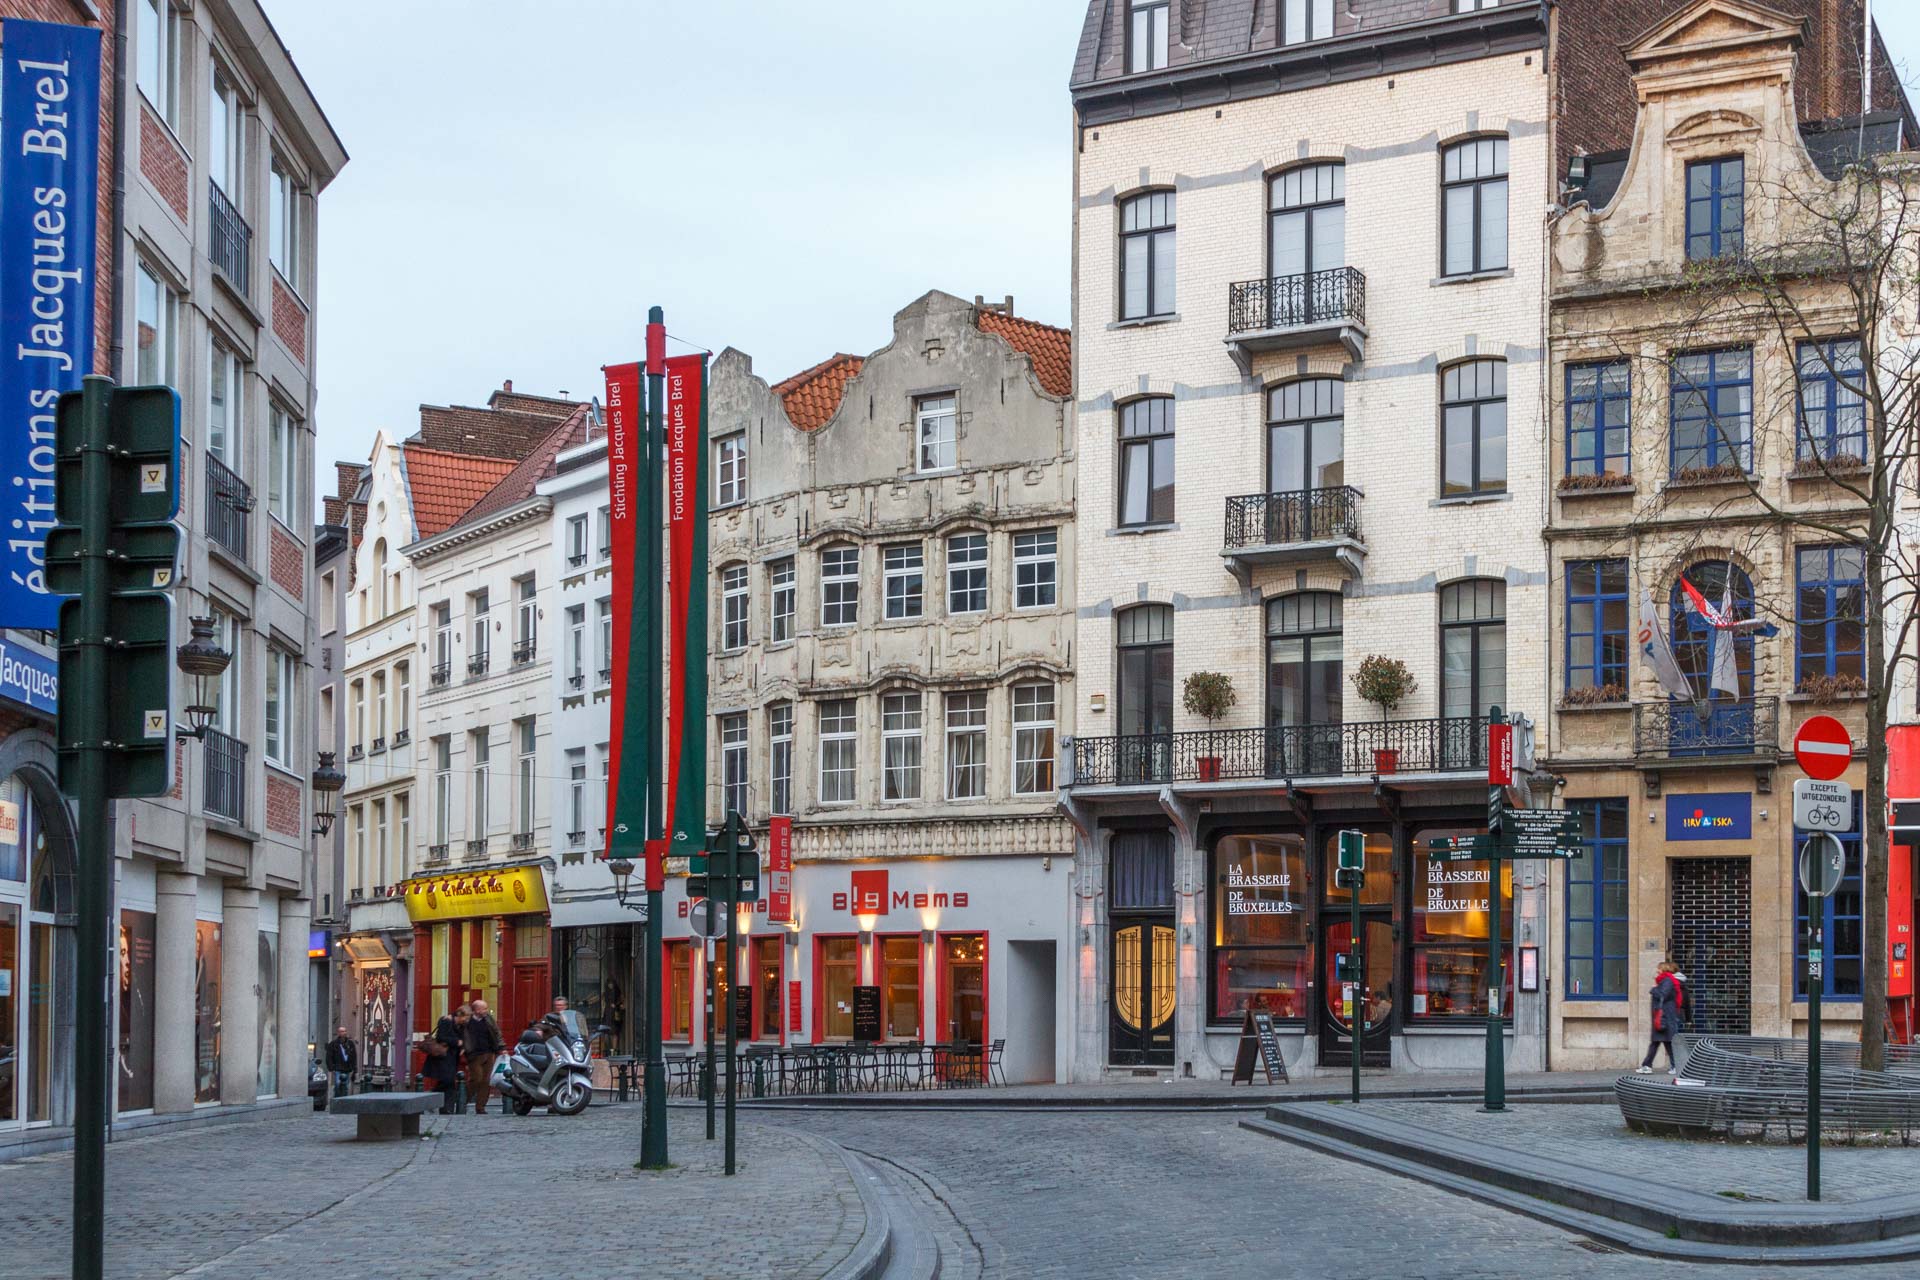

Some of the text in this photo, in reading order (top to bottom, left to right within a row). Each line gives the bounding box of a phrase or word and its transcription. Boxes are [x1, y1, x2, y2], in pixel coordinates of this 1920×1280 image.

[9, 59, 82, 594] éditions Jacques Brel
[610, 382, 627, 520] Stichting Jacques Brel
[671, 375, 686, 521] Fondation Jacques Brel
[0, 644, 58, 705] Jacques
[1801, 792, 1847, 803] UITGEZONDERD
[1229, 864, 1243, 875] LA
[1427, 860, 1443, 870] LA
[1229, 874, 1291, 887] BRASSERIE
[1229, 891, 1244, 901] DE
[1427, 887, 1444, 898] DE
[1229, 901, 1293, 913] BRUXELLES
